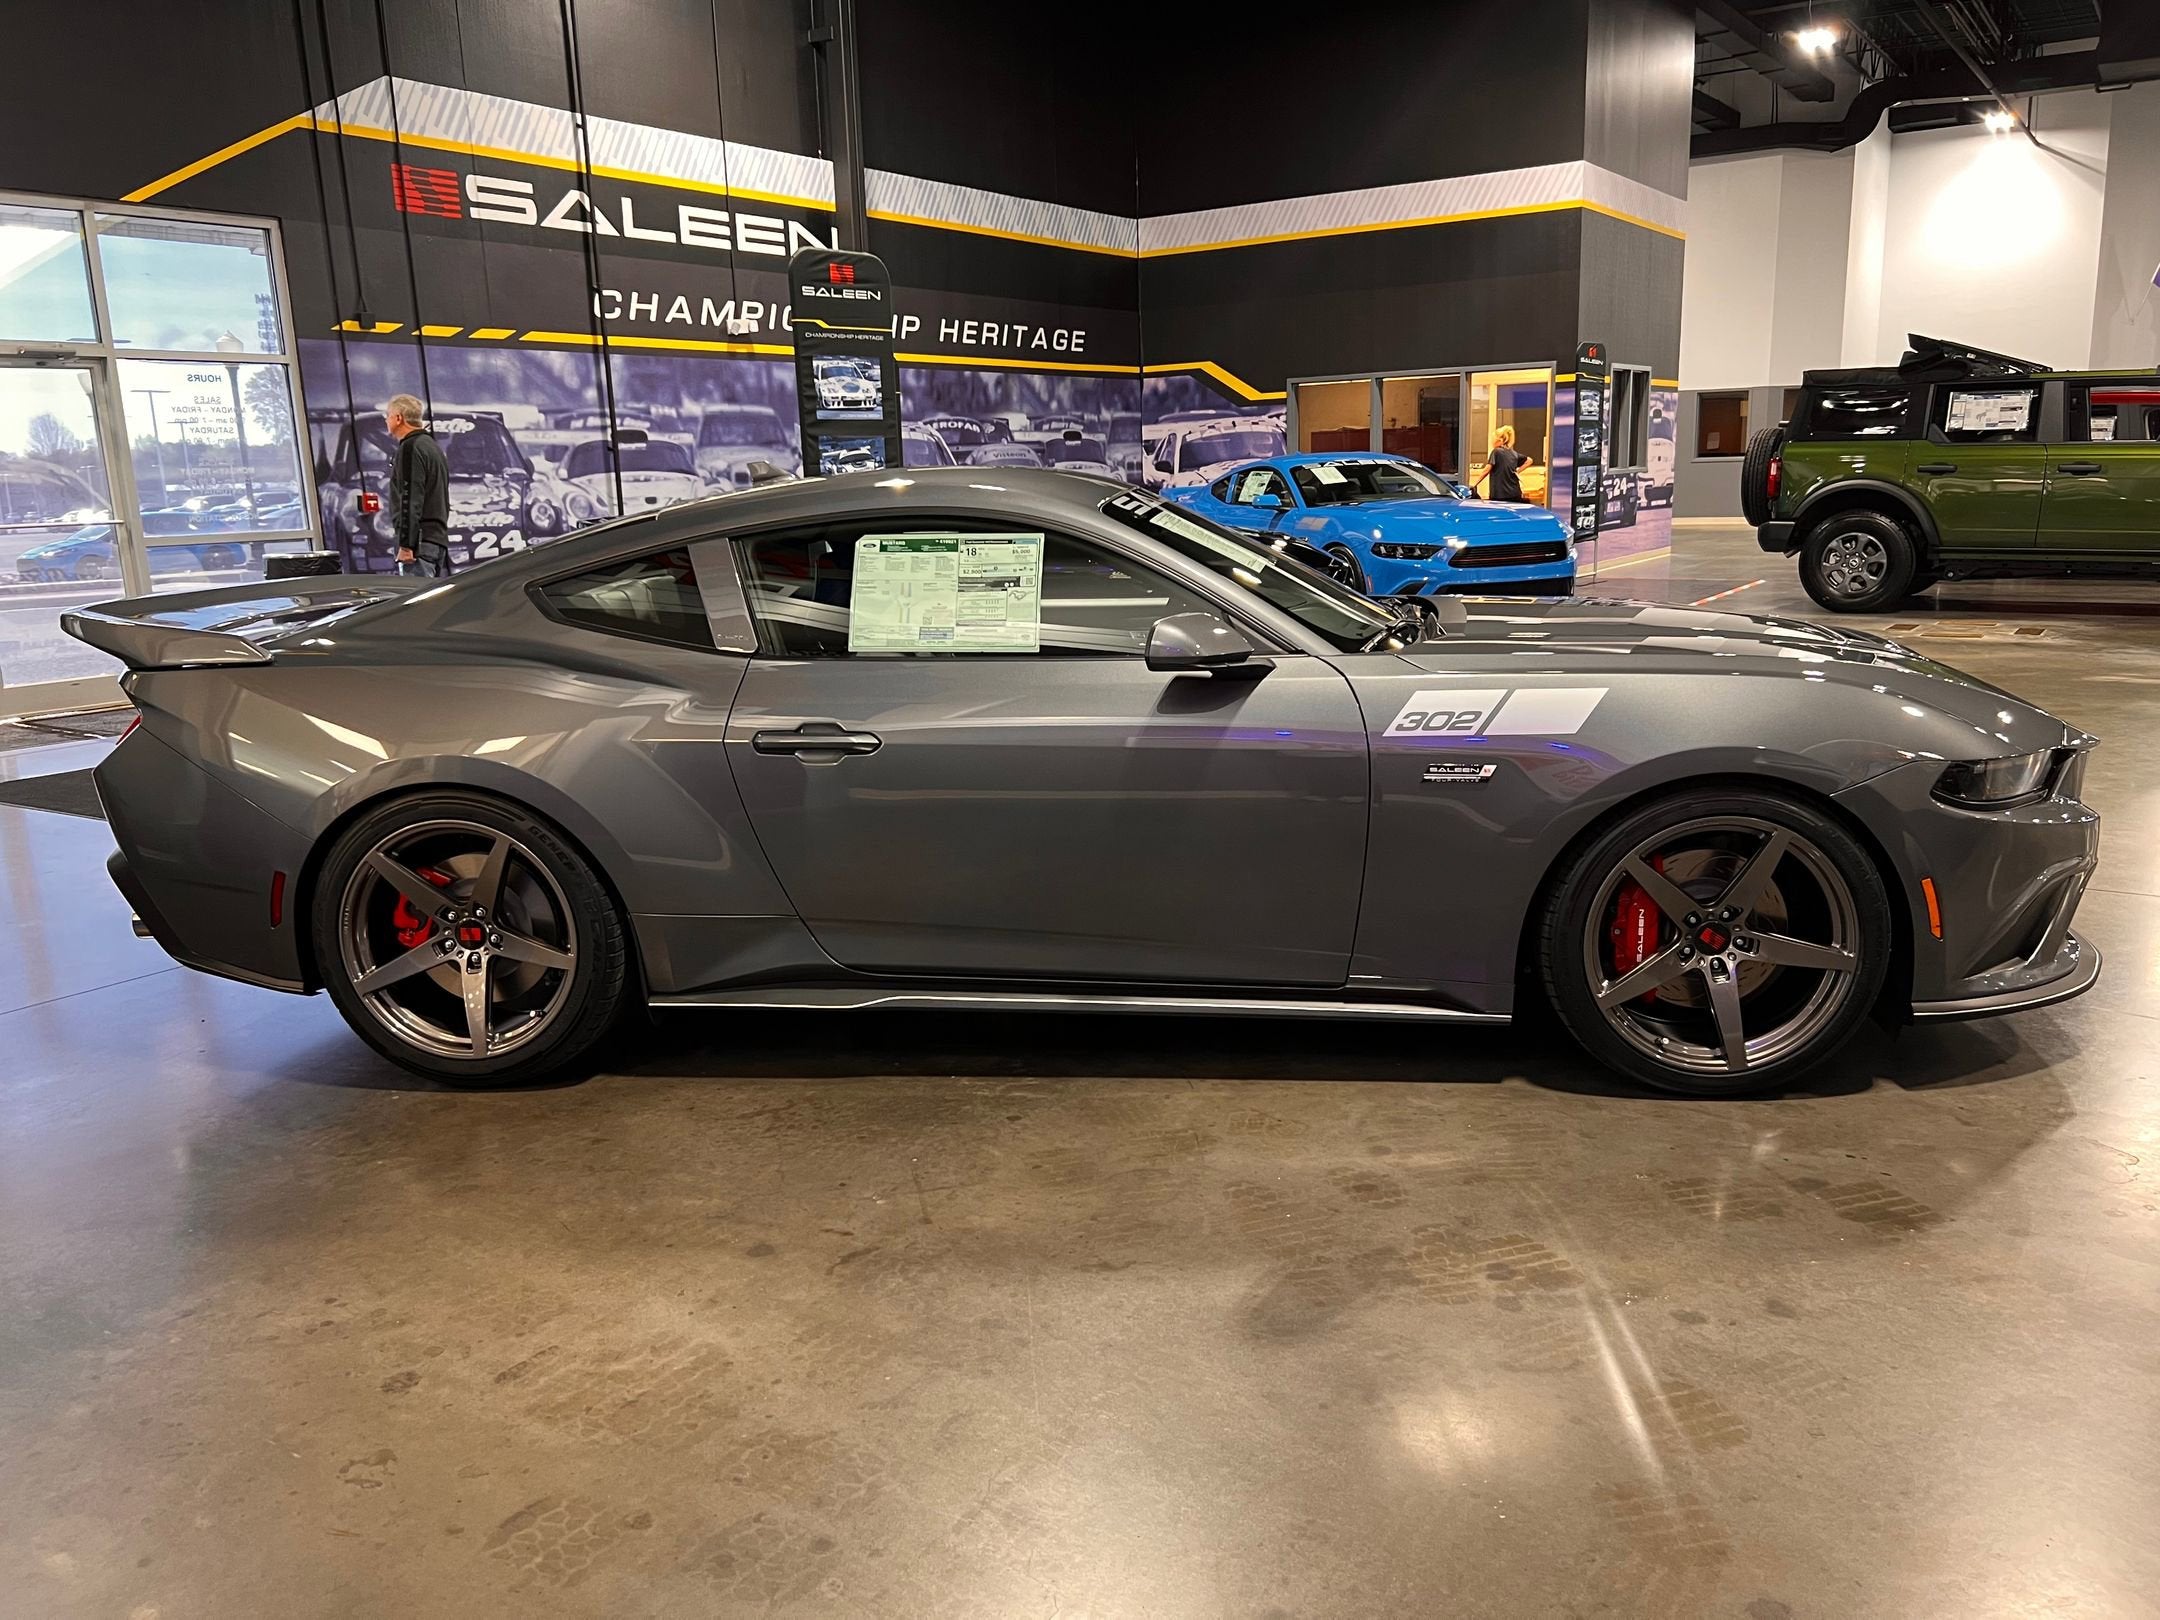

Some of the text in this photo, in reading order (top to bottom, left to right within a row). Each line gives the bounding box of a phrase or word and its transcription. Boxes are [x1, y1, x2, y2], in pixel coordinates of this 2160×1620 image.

[465, 173, 839, 257] SALEEN
[801, 286, 881, 300] SALEEN
[593, 289, 1086, 352] CHAMPIIP HERITAGE
[805, 331, 884, 341] CHAMPIONSHIP HERITAGE
[1580, 356, 1603, 366] SALEEN
[1613, 477, 1628, 497] 24
[471, 530, 527, 559] 24
[966, 547, 977, 557] 18
[1395, 711, 1483, 731] 302
[1636, 908, 1645, 963] SALEEN
